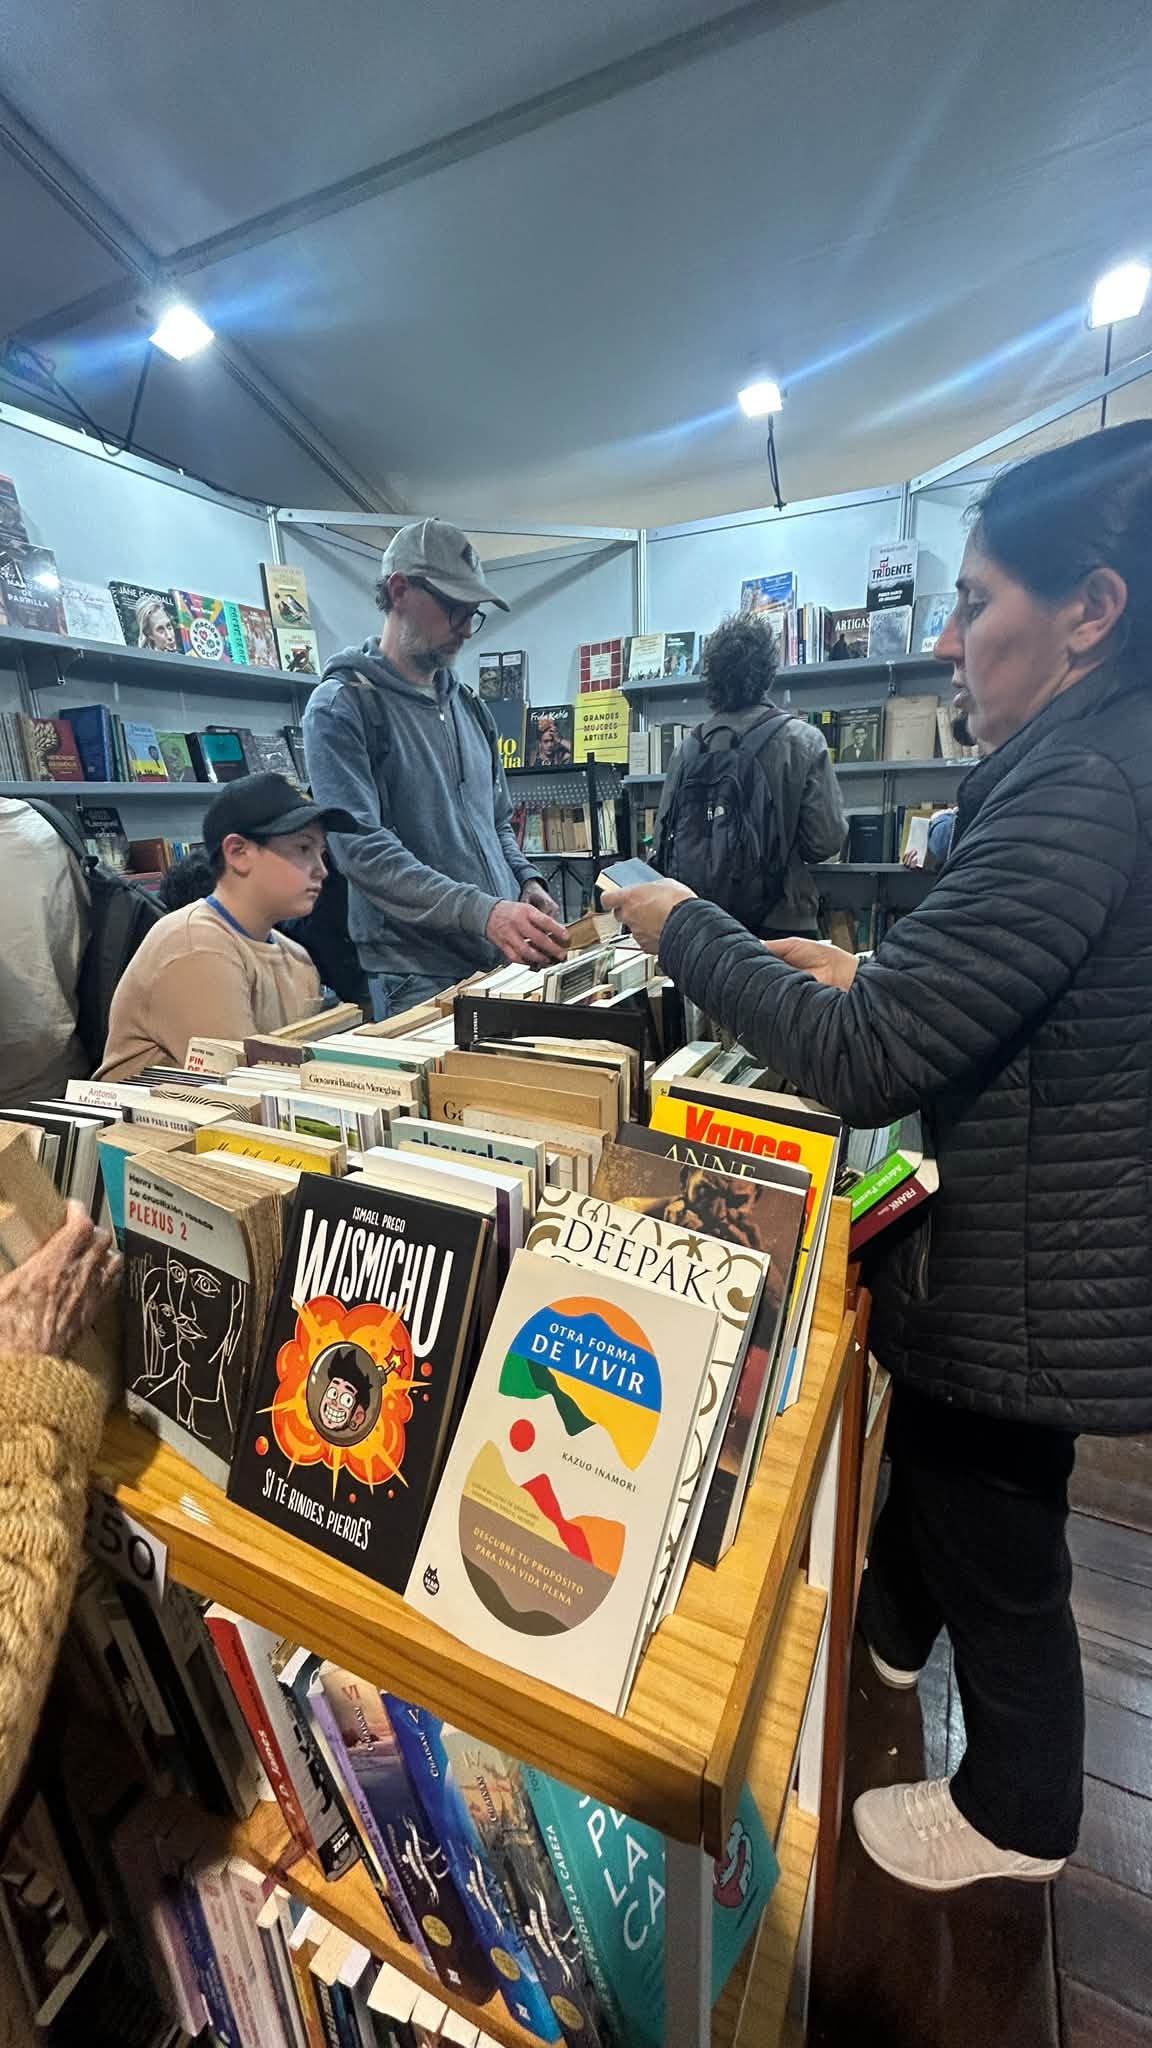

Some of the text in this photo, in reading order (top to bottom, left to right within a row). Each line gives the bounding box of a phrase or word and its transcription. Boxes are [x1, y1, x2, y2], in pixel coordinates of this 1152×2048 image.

[871, 563, 912, 580] TRIDENTE
[119, 586, 138, 598] JANE
[139, 591, 174, 606] GOODALL
[835, 618, 870, 631] ARTIGAS
[530, 710, 569, 721] Frida Kahlo
[583, 712, 619, 722] GRANDES
[583, 723, 618, 732] MUJERES
[583, 733, 618, 742] ARTISTAS
[189, 1056, 204, 1066] FIN
[88, 1087, 118, 1100] Antonio
[309, 1073, 401, 1097] Giovanni Battista Meneghini
[684, 1104, 802, 1163] Vance
[664, 1143, 756, 1178] ANNE
[129, 1188, 140, 1198] La
[888, 1187, 917, 1211] FRANK
[129, 1200, 187, 1241] PLEXUS 2
[352, 1206, 406, 1233] ISMAEL PREGO
[563, 1219, 713, 1304] DEEPAK
[292, 1209, 454, 1358] WISMICHU
[549, 1323, 637, 1365] OTRA FORMA
[531, 1333, 645, 1394] DE VIVIR
[562, 1451, 637, 1493] KAZUO INAMORI
[262, 1468, 275, 1499] SI
[275, 1477, 289, 1504] TE
[326, 1510, 372, 1550] PIERDES
[473, 1527, 515, 1556] DESCUBRE
[518, 1552, 529, 1564] TU
[475, 1543, 571, 1606] PARA UNA VIDA PLENA
[258, 1730, 282, 1777] James
[332, 1831, 350, 1852] ZETA
[545, 1825, 570, 1881] CABEZA
[569, 1882, 578, 1901] LA
[571, 1903, 598, 1962] PERDER
